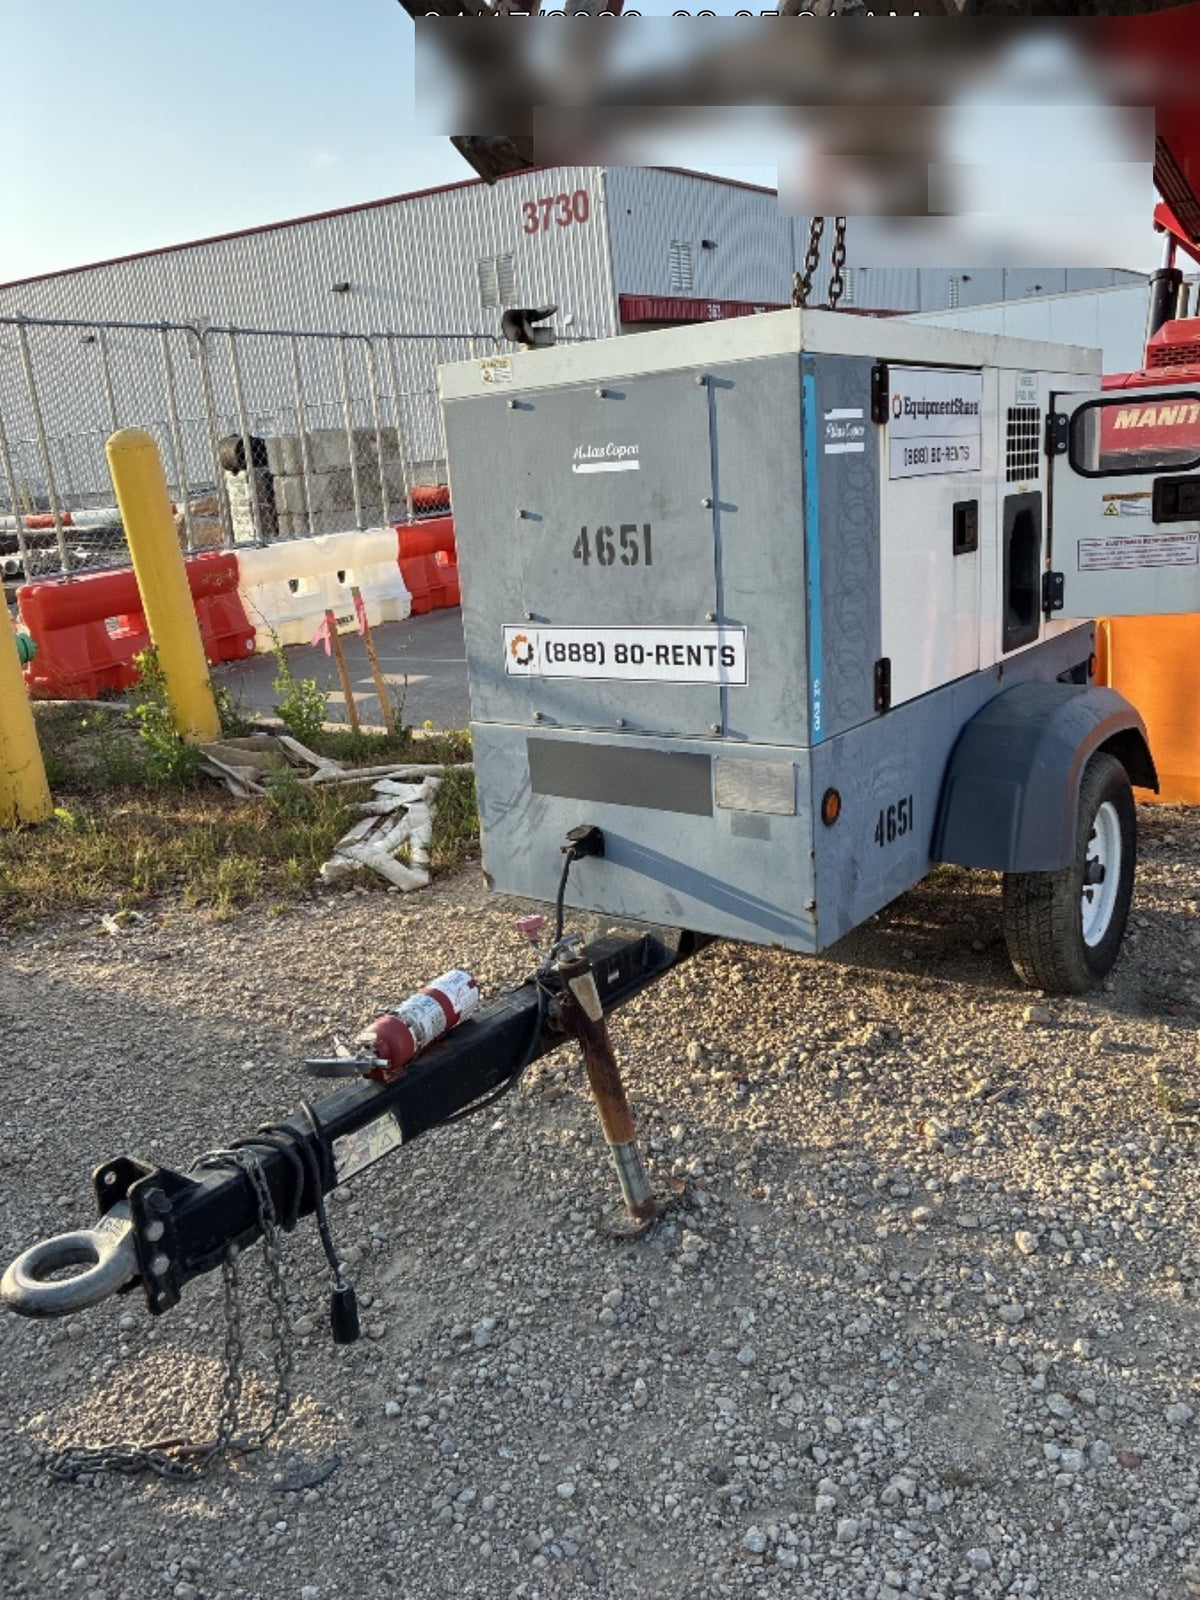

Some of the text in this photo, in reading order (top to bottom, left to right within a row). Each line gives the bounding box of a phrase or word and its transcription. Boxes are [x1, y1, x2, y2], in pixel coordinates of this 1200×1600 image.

[522, 189, 589, 234] 3730
[903, 396, 979, 420] EquipmentShare
[572, 523, 653, 566] 4651
[545, 641, 736, 667] (888) 80-RENTS
[874, 794, 913, 848] 4651
